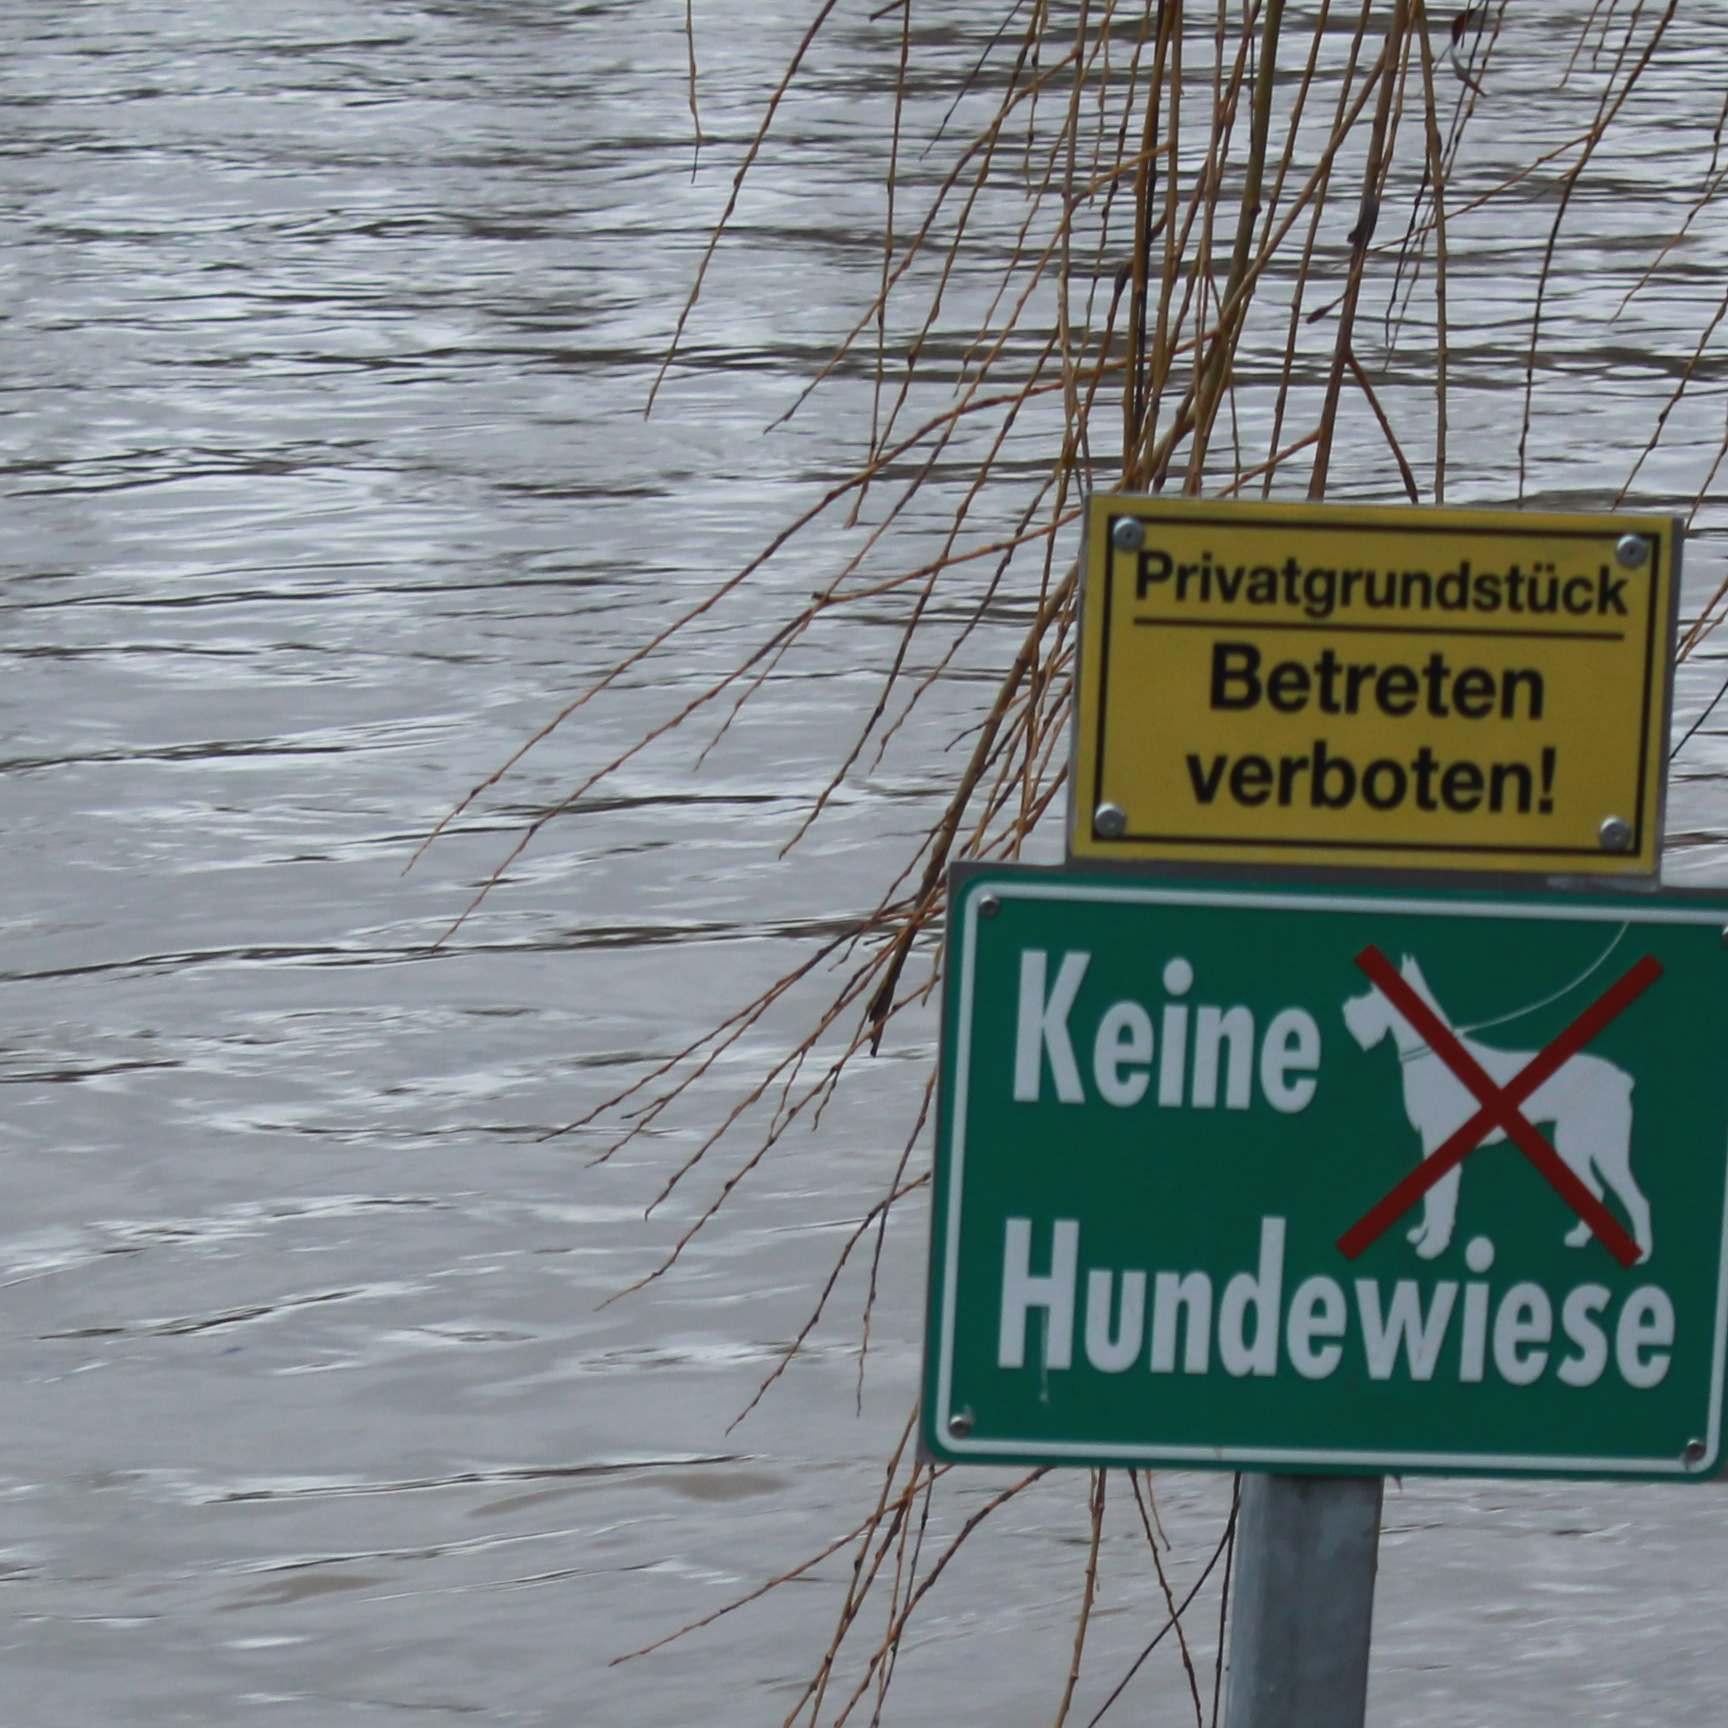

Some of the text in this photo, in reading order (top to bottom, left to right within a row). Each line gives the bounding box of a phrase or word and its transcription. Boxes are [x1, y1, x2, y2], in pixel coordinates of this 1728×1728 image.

[1134, 549, 1628, 620] Privatgrundstück
[1209, 642, 1544, 720] Betreten
[1185, 740, 1557, 815] verboten!
[1013, 949, 1322, 1114] Keine
[997, 1216, 1675, 1389] Hundewiese
